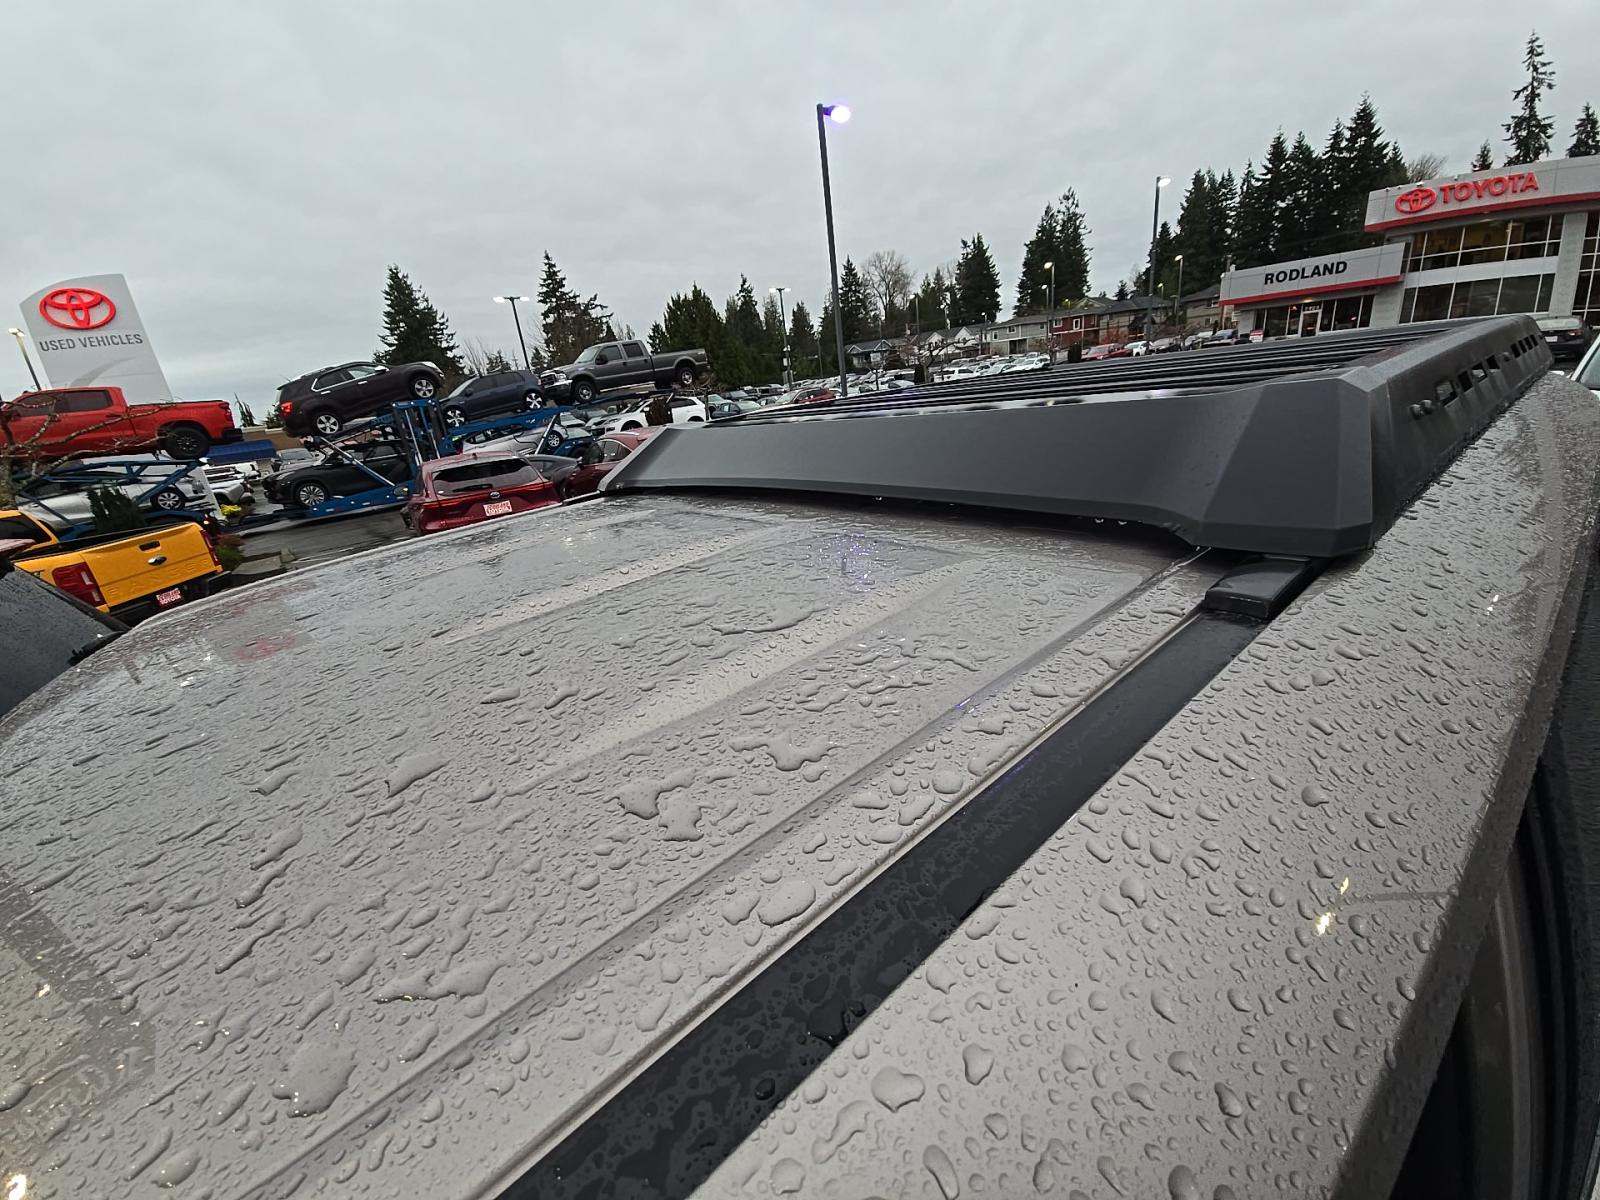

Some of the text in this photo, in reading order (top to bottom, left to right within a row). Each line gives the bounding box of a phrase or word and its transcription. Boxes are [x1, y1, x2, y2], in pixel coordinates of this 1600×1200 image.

[1439, 171, 1539, 204] TOYOTA
[1264, 261, 1348, 285] RODLAND
[40, 333, 144, 352] USED VEHICLES
